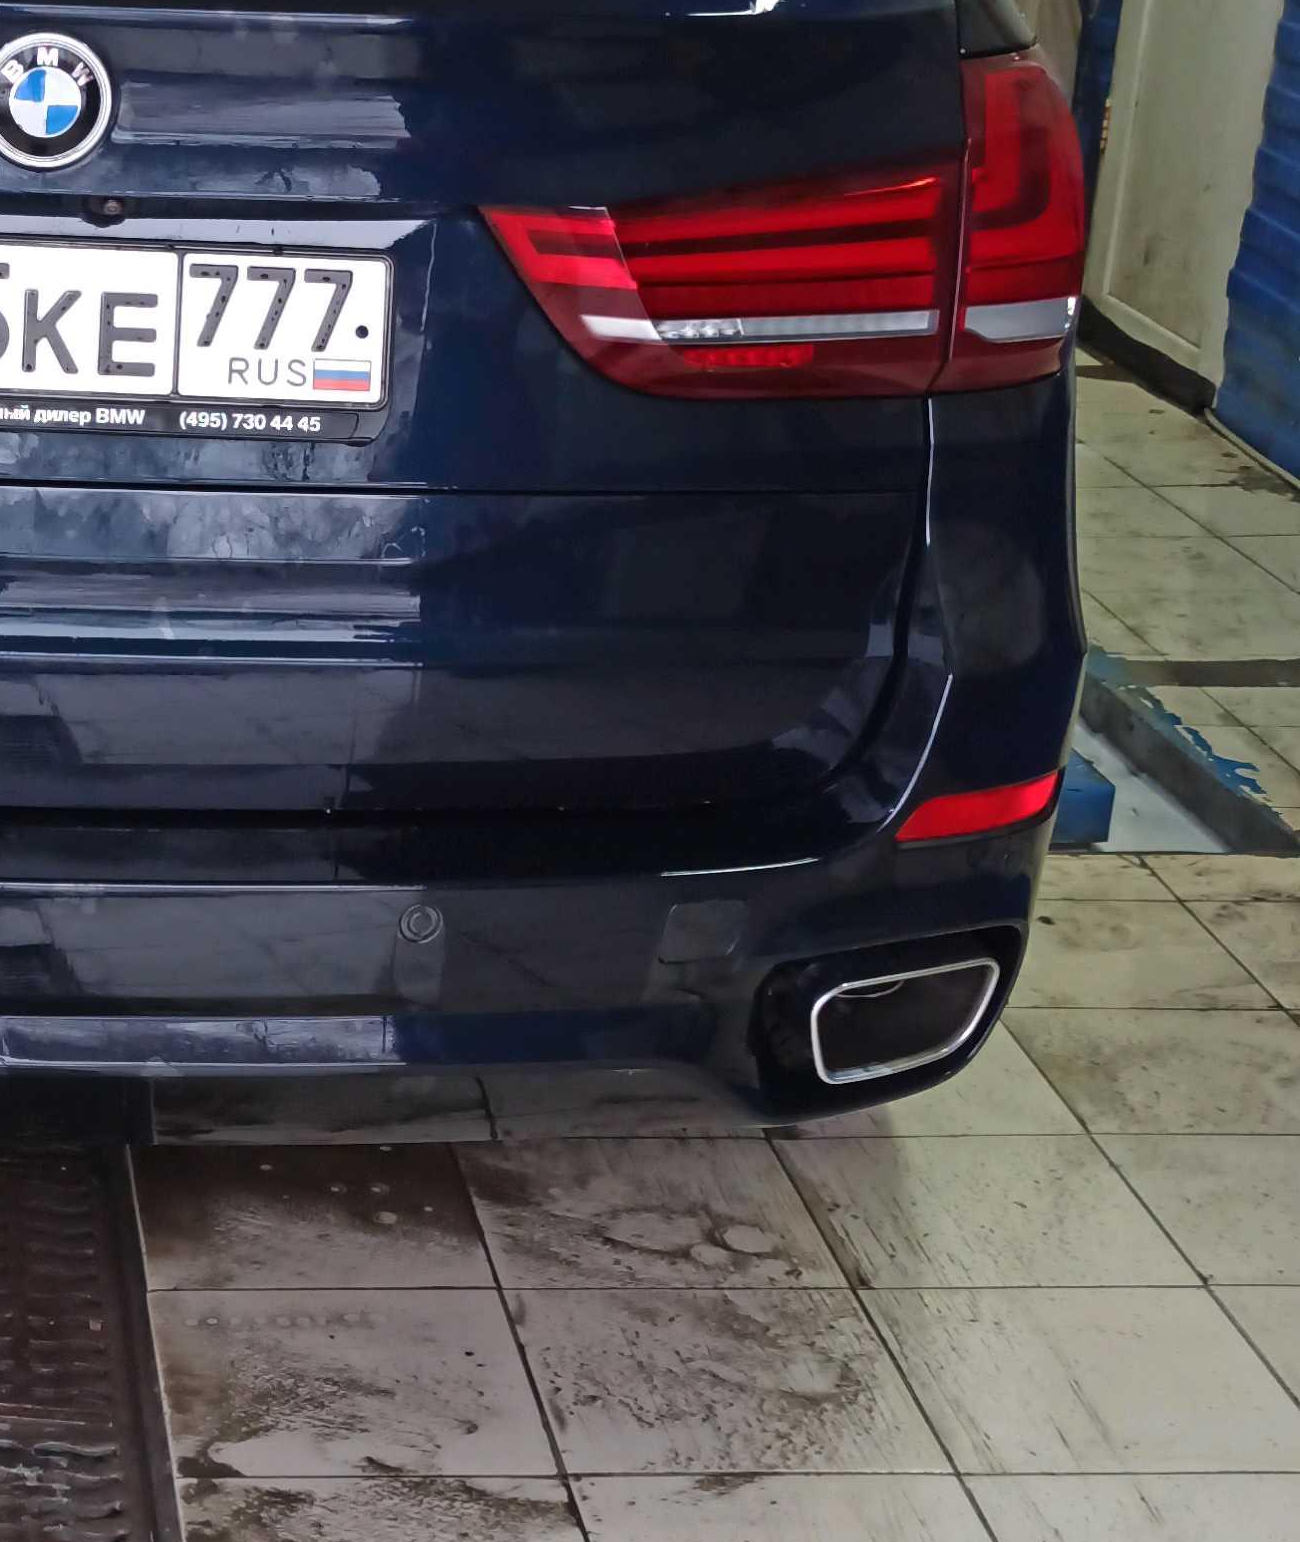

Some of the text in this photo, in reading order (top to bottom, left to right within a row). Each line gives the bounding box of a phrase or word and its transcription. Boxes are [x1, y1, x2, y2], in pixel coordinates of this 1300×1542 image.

[0, 46, 93, 87] BMW
[189, 263, 353, 352] 777
[227, 357, 307, 387] RUS
[179, 410, 228, 431] (495)
[232, 412, 267, 431] 730
[270, 414, 294, 432] 44
[297, 415, 321, 433] 45
